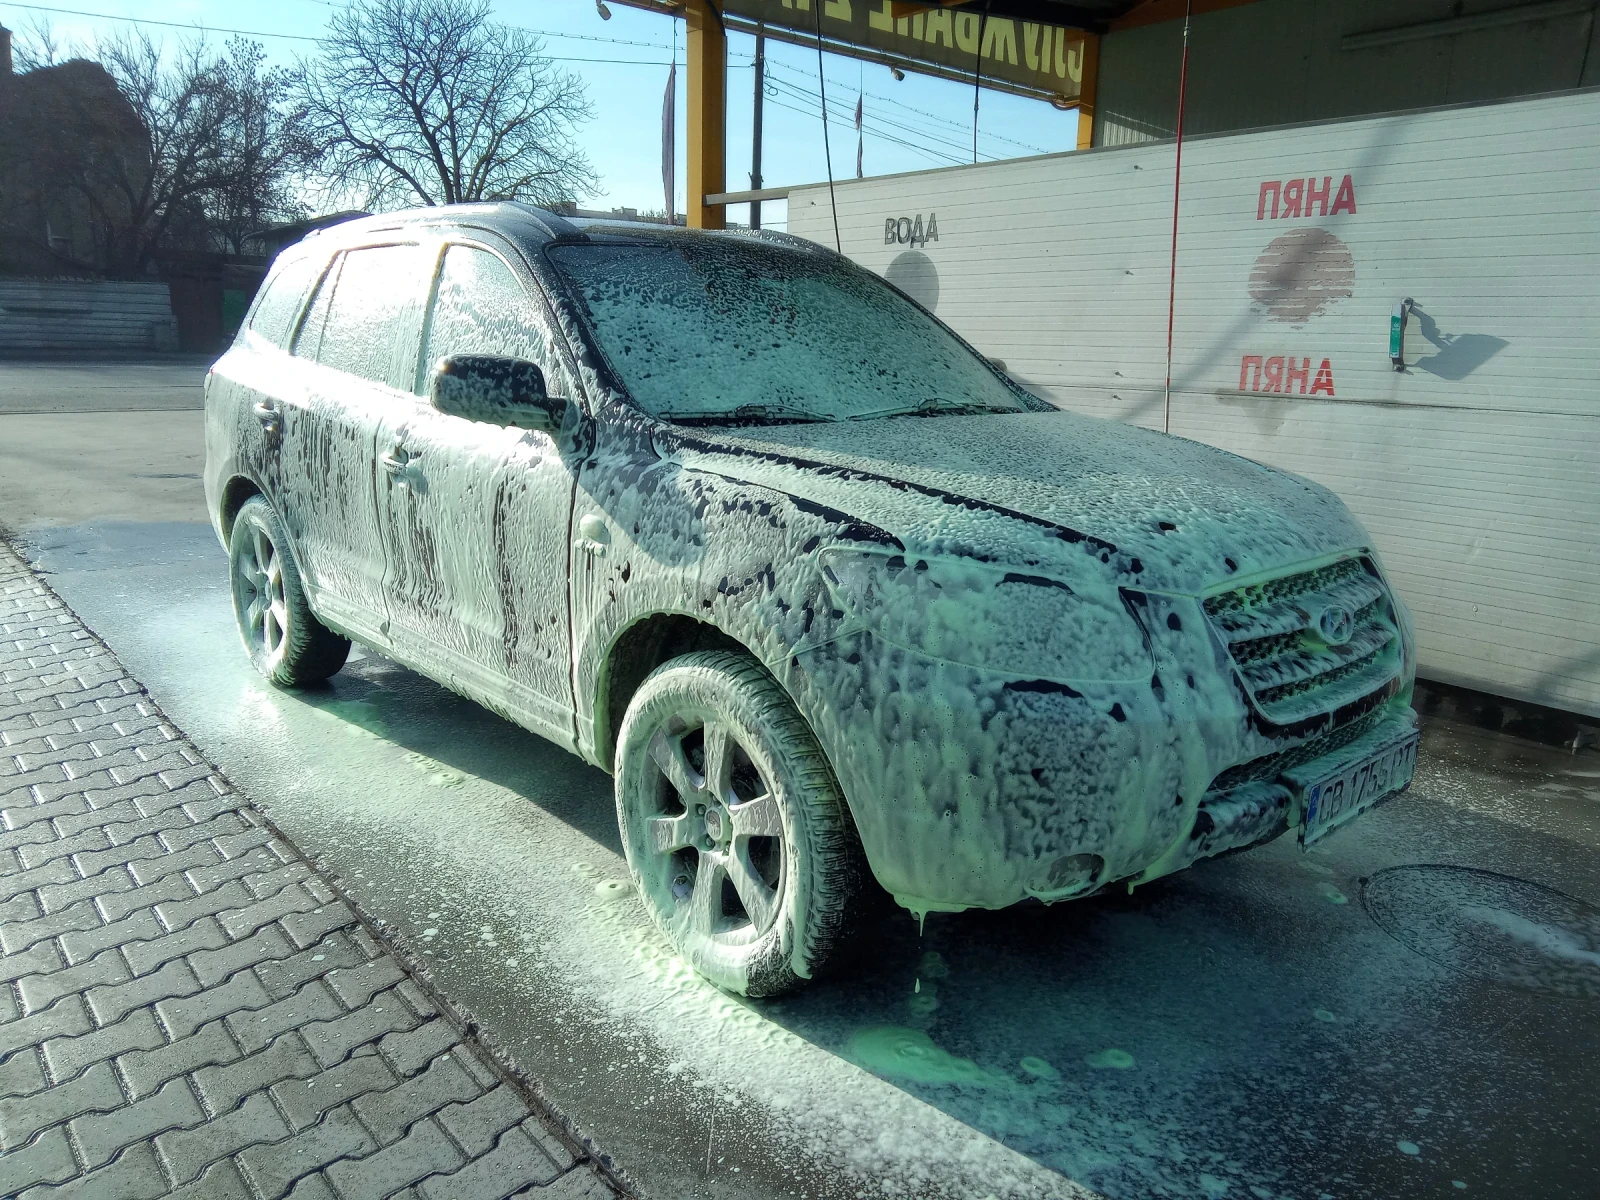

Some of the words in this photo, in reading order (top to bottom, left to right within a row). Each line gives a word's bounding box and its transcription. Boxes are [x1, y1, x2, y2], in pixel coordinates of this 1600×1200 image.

[1256, 174, 1357, 221] ПЯНА
[884, 212, 939, 249] ВОДА
[1238, 355, 1336, 396] ПЯНА
